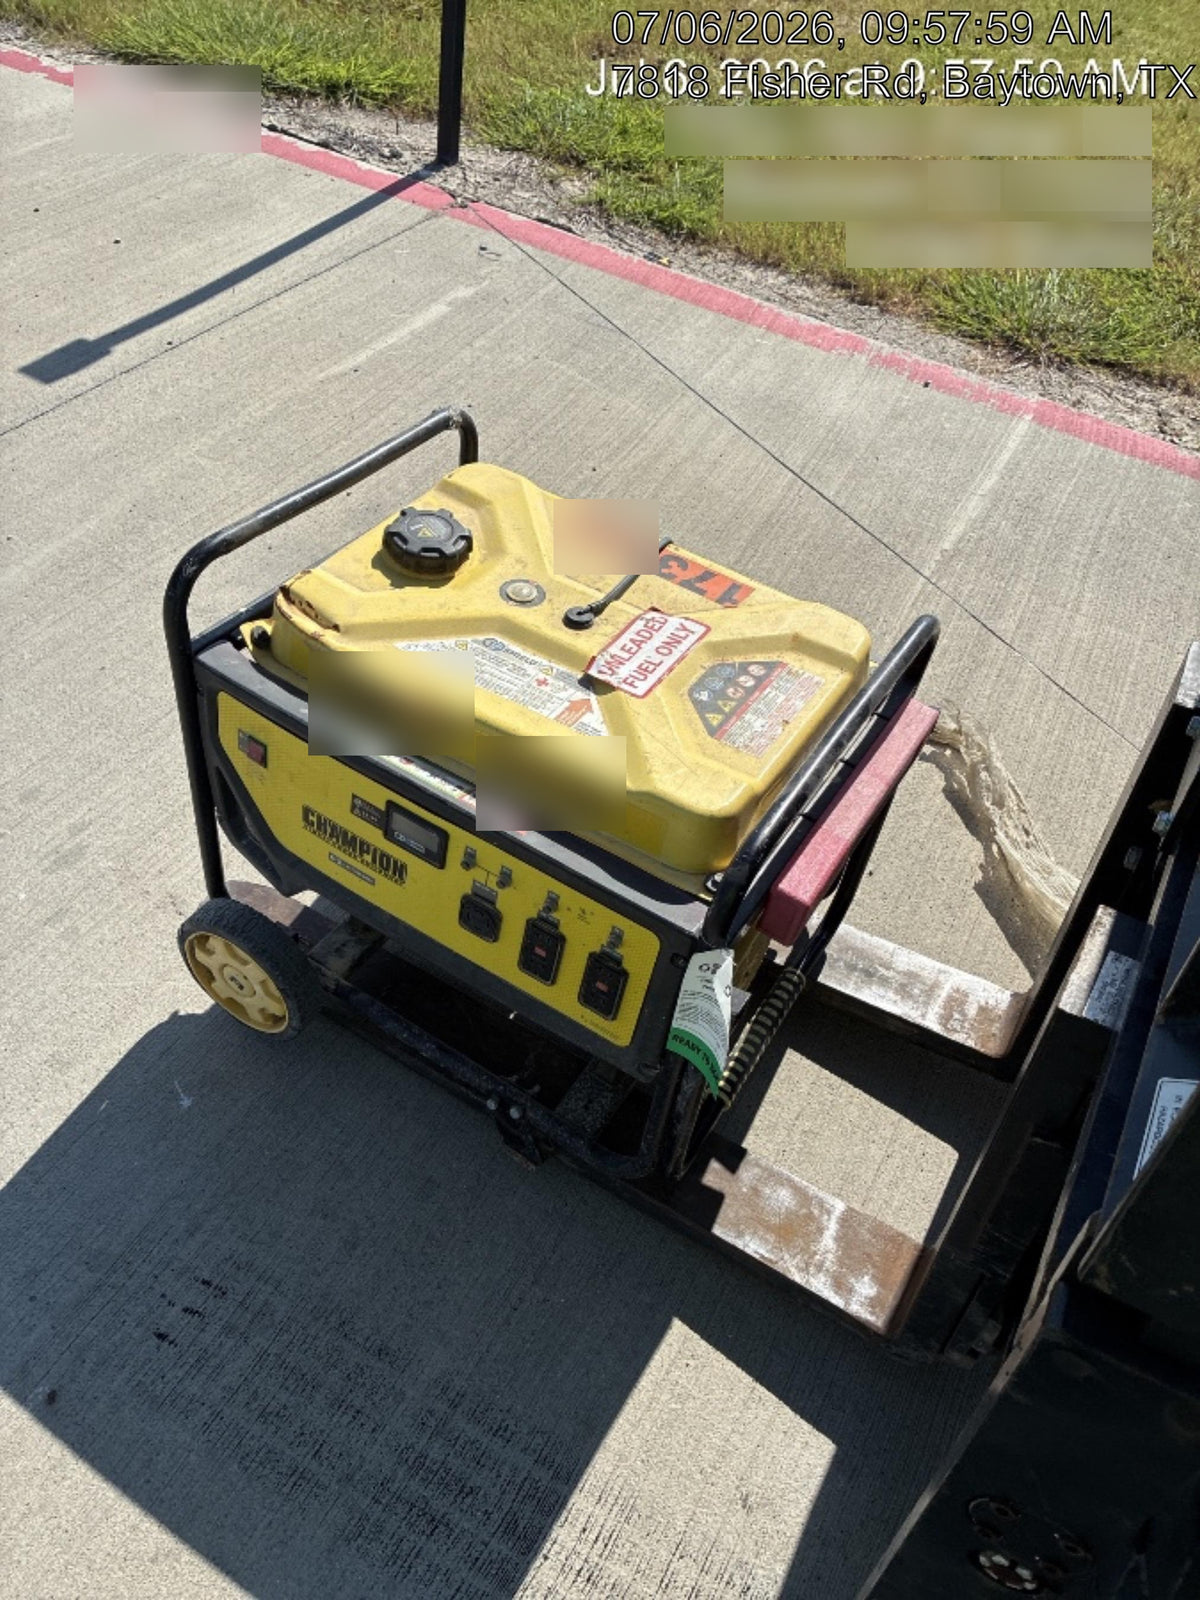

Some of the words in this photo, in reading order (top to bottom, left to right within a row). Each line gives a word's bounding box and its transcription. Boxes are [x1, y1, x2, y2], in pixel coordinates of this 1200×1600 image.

[597, 617, 668, 676] UNLEADED
[622, 659, 663, 689] FUEL
[655, 622, 696, 657] ONLY
[302, 803, 408, 882] CHAMPION
